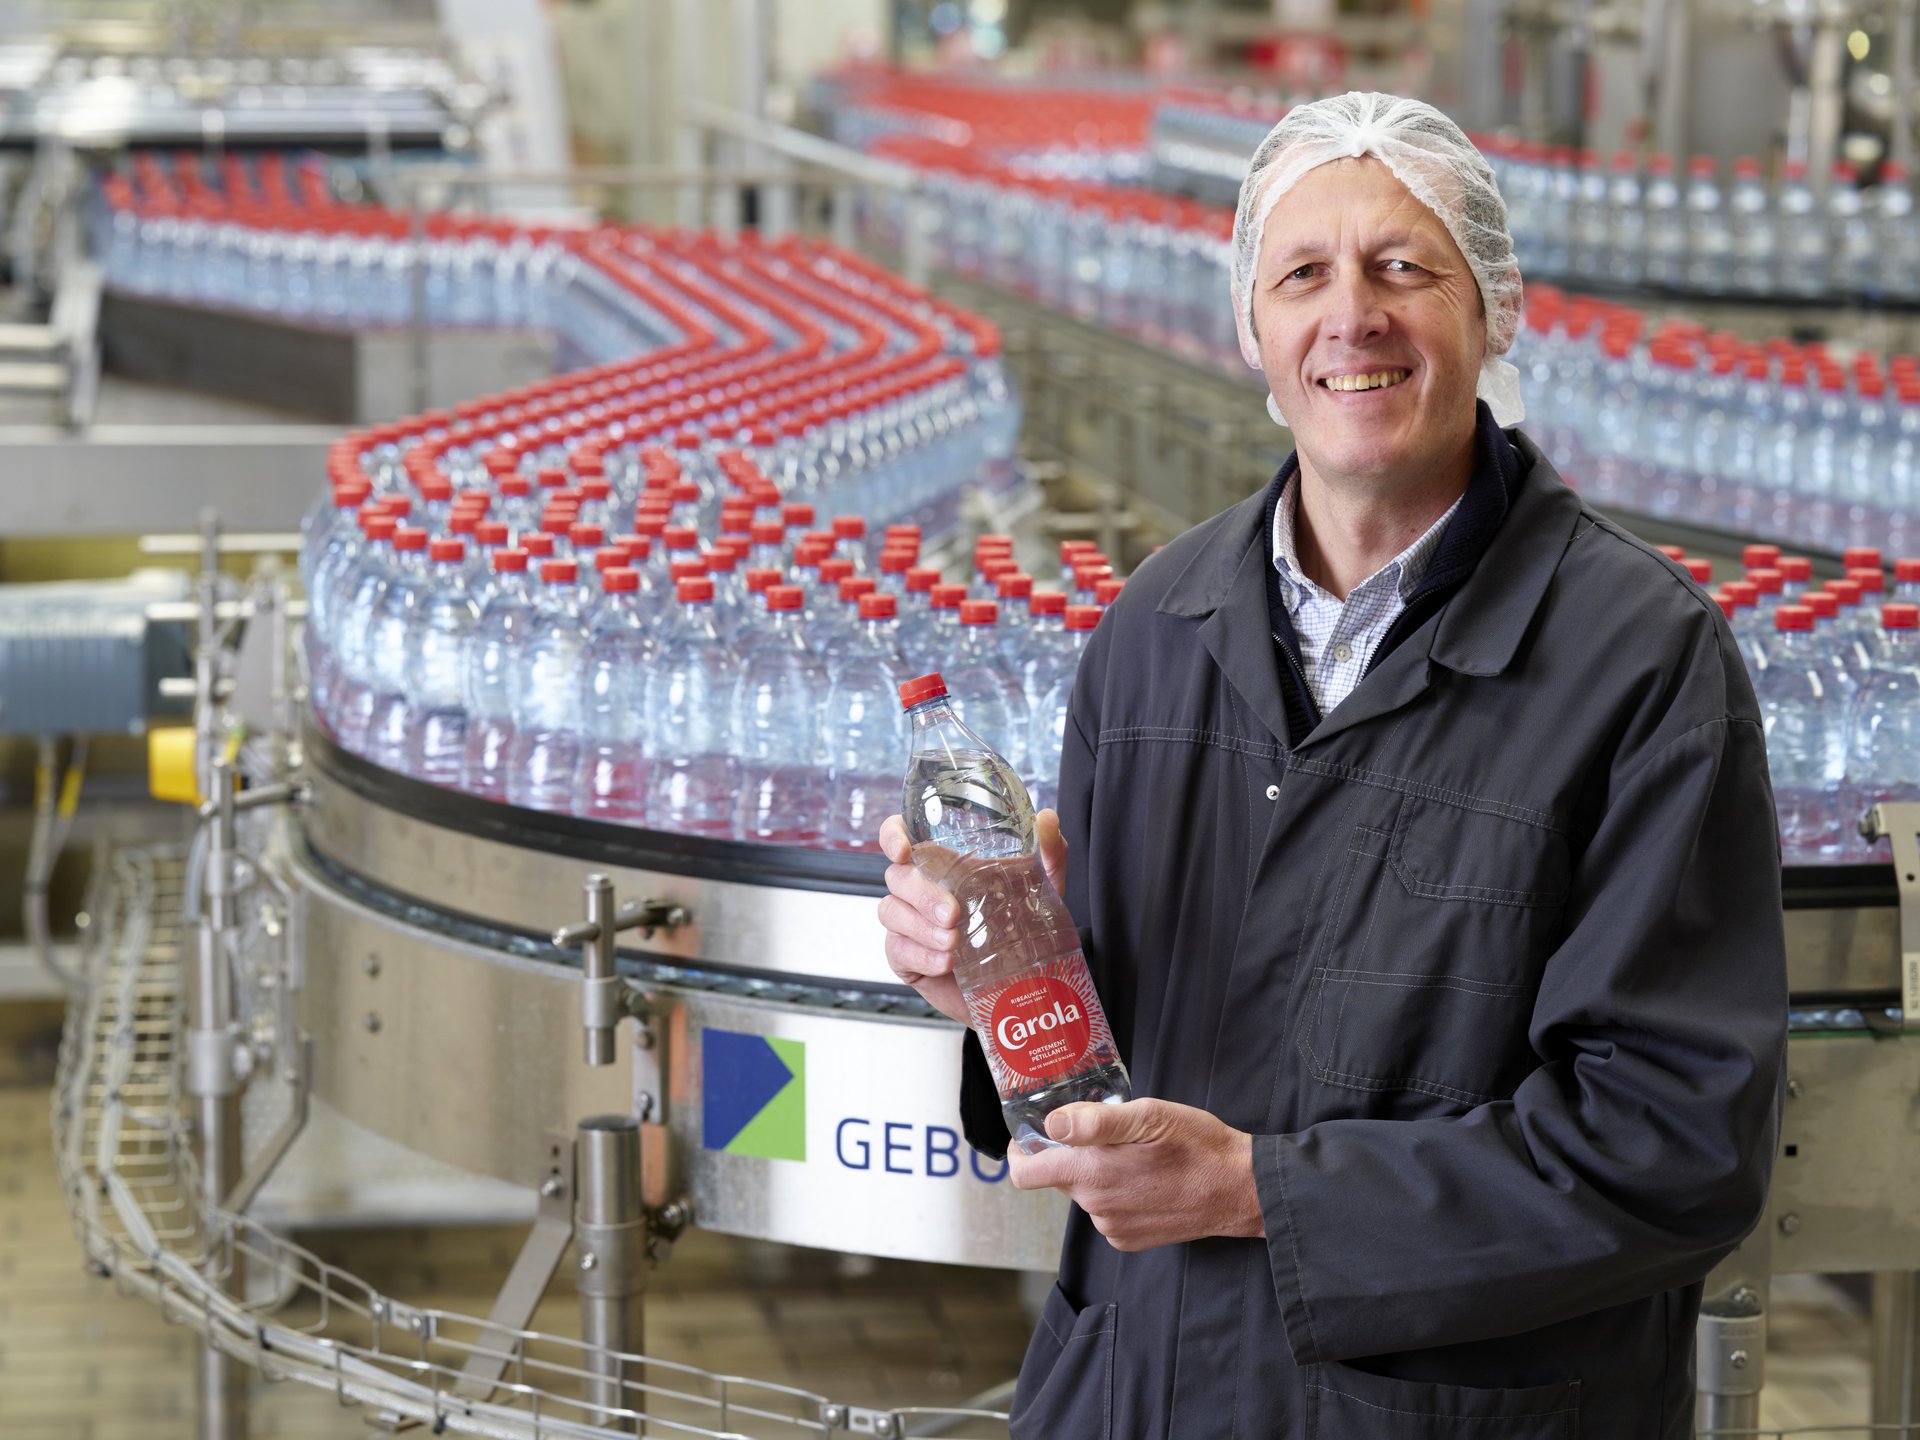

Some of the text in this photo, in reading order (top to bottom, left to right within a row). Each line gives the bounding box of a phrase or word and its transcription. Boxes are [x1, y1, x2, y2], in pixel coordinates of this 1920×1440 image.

[1010, 986, 1047, 1004] RIBEAUVILLÉ
[997, 1001, 1080, 1050] Carola
[1029, 1039, 1066, 1056] FORTEMENT
[1031, 1045, 1068, 1062] PÉTILLANTE
[1042, 1058, 1058, 1067] SOURCE
